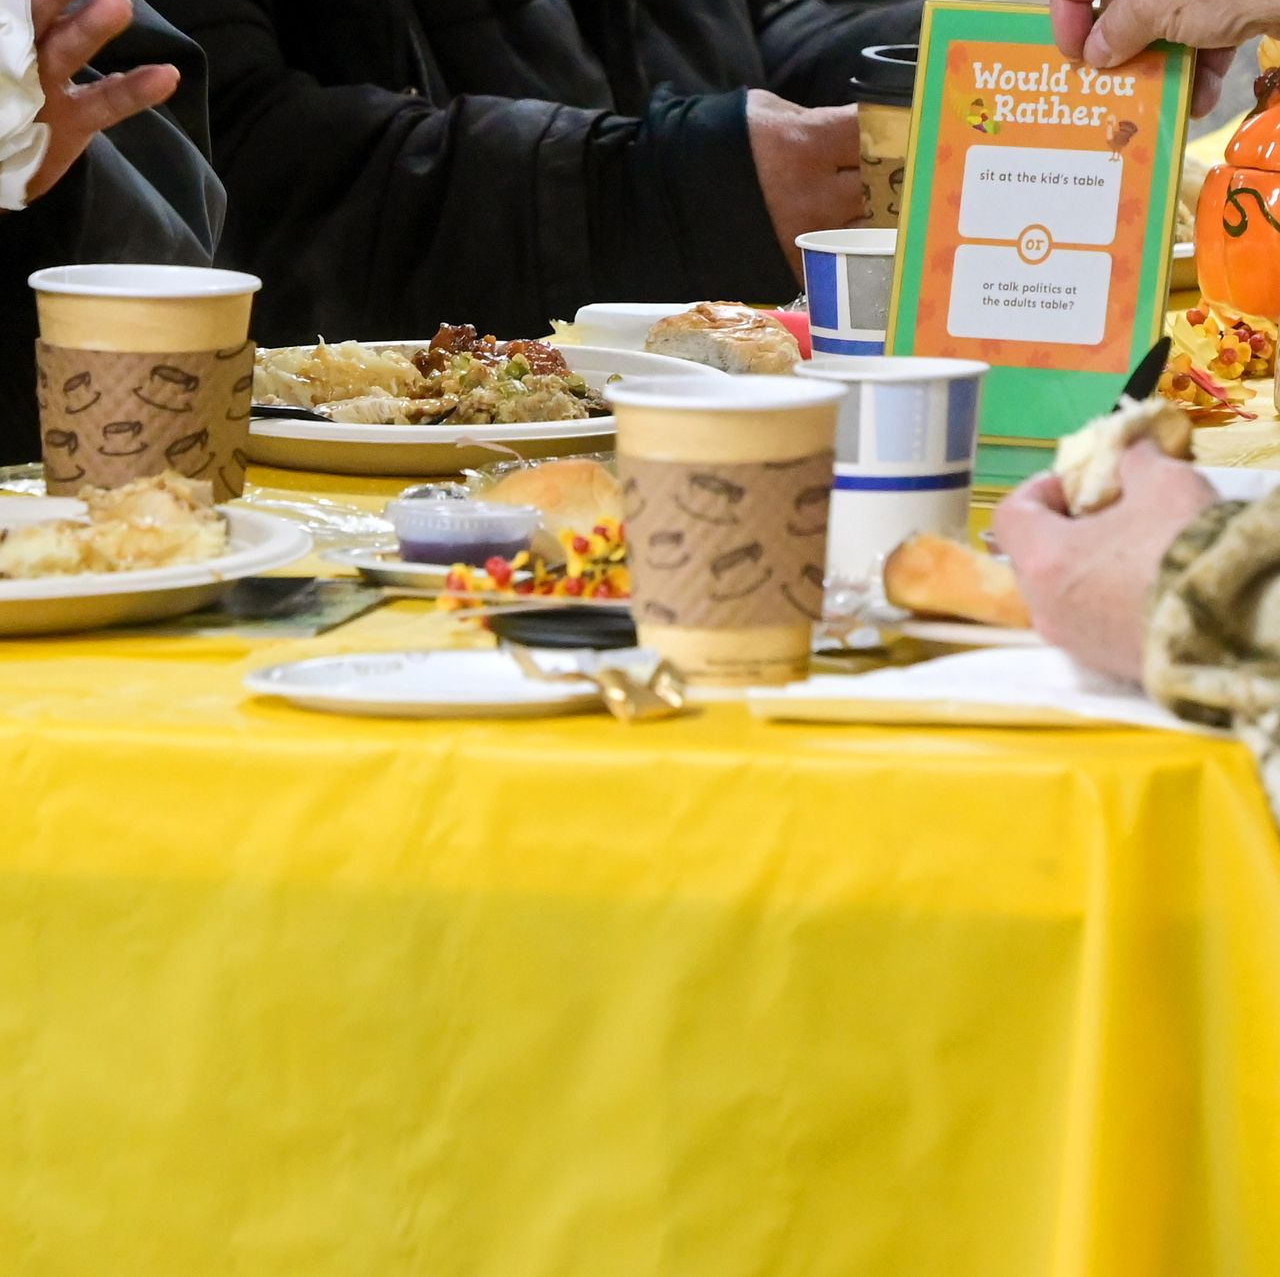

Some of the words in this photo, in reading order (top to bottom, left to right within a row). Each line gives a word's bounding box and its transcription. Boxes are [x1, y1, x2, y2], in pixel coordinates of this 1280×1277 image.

[972, 61, 1071, 93] Would
[1077, 66, 1136, 97] You
[993, 93, 1108, 127] Rather
[980, 169, 995, 181] sit
[999, 172, 1012, 182] at
[1017, 171, 1037, 183] the
[1041, 172, 1069, 185] kid's
[1073, 175, 1105, 187] table
[1025, 239, 1045, 251] or
[982, 282, 995, 290] or
[998, 281, 1019, 291] talk
[1022, 282, 1062, 295] politics
[1065, 286, 1077, 295] at
[982, 295, 1000, 306] the
[1003, 297, 1036, 308] adults
[1040, 299, 1074, 310] table?
